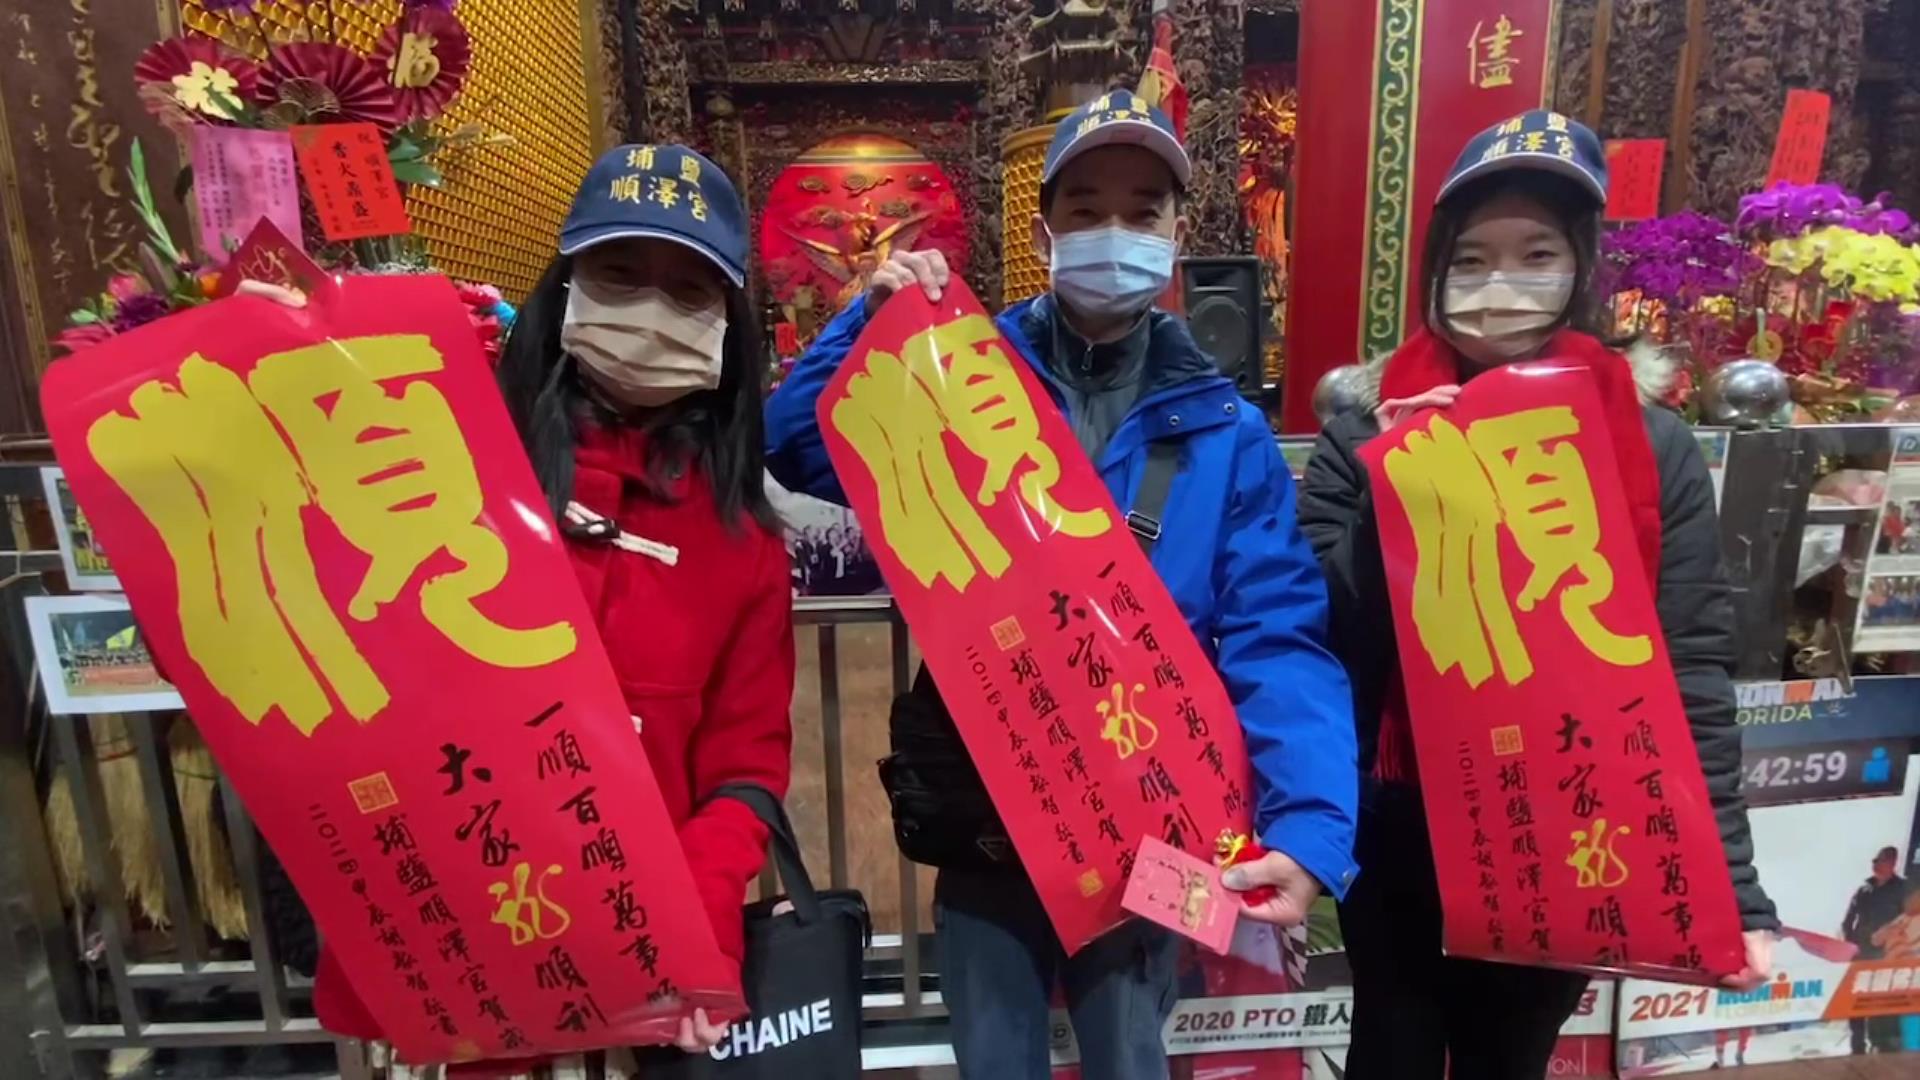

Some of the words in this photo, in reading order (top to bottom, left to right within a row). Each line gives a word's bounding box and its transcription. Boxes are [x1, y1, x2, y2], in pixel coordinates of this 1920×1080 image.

[609, 174, 708, 222] 順澤宮
[626, 146, 701, 188] 埔鹽
[830, 313, 1112, 594] 順
[86, 333, 578, 738] 順
[1383, 405, 1653, 690] 順
[1496, 760, 1551, 960] 埔鹽順澤宮賀
[1174, 1010, 1235, 1033] 2020
[1243, 1008, 1296, 1028] PTO
[1629, 988, 1710, 1023] 2021
